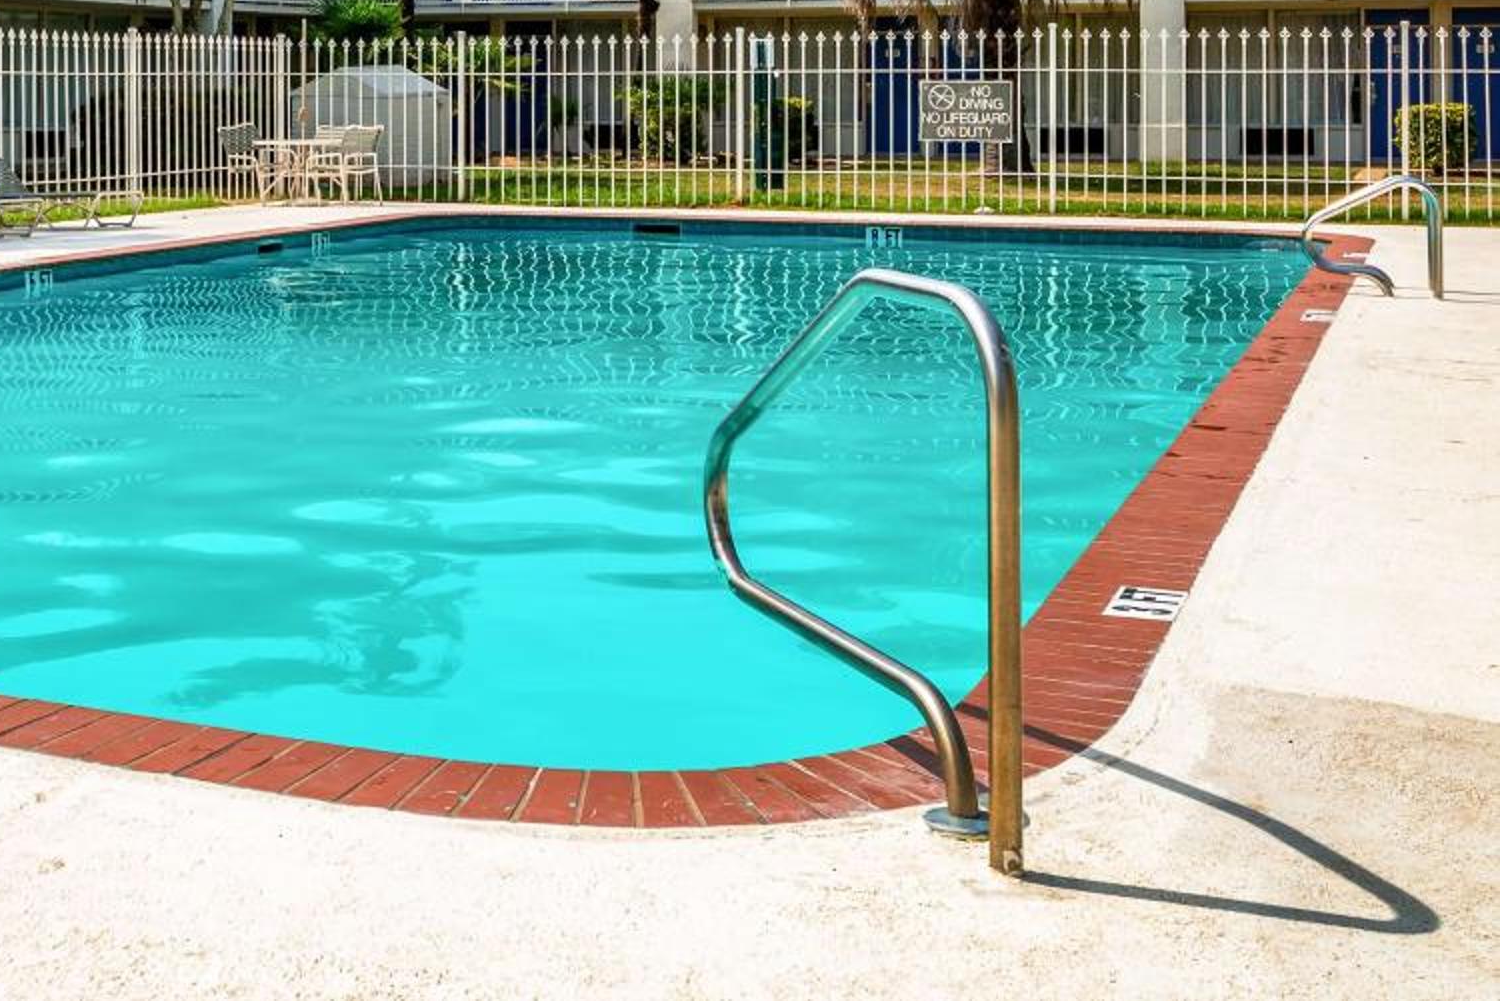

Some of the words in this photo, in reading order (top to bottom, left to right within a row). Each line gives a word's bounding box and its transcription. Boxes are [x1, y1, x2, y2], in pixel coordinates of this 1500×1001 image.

[971, 85, 991, 98] NO
[959, 98, 1004, 110] DIVING
[923, 111, 941, 124] NO
[943, 111, 1009, 124] LIFEGUARD
[937, 125, 956, 138] ON
[959, 125, 994, 138] DUTY
